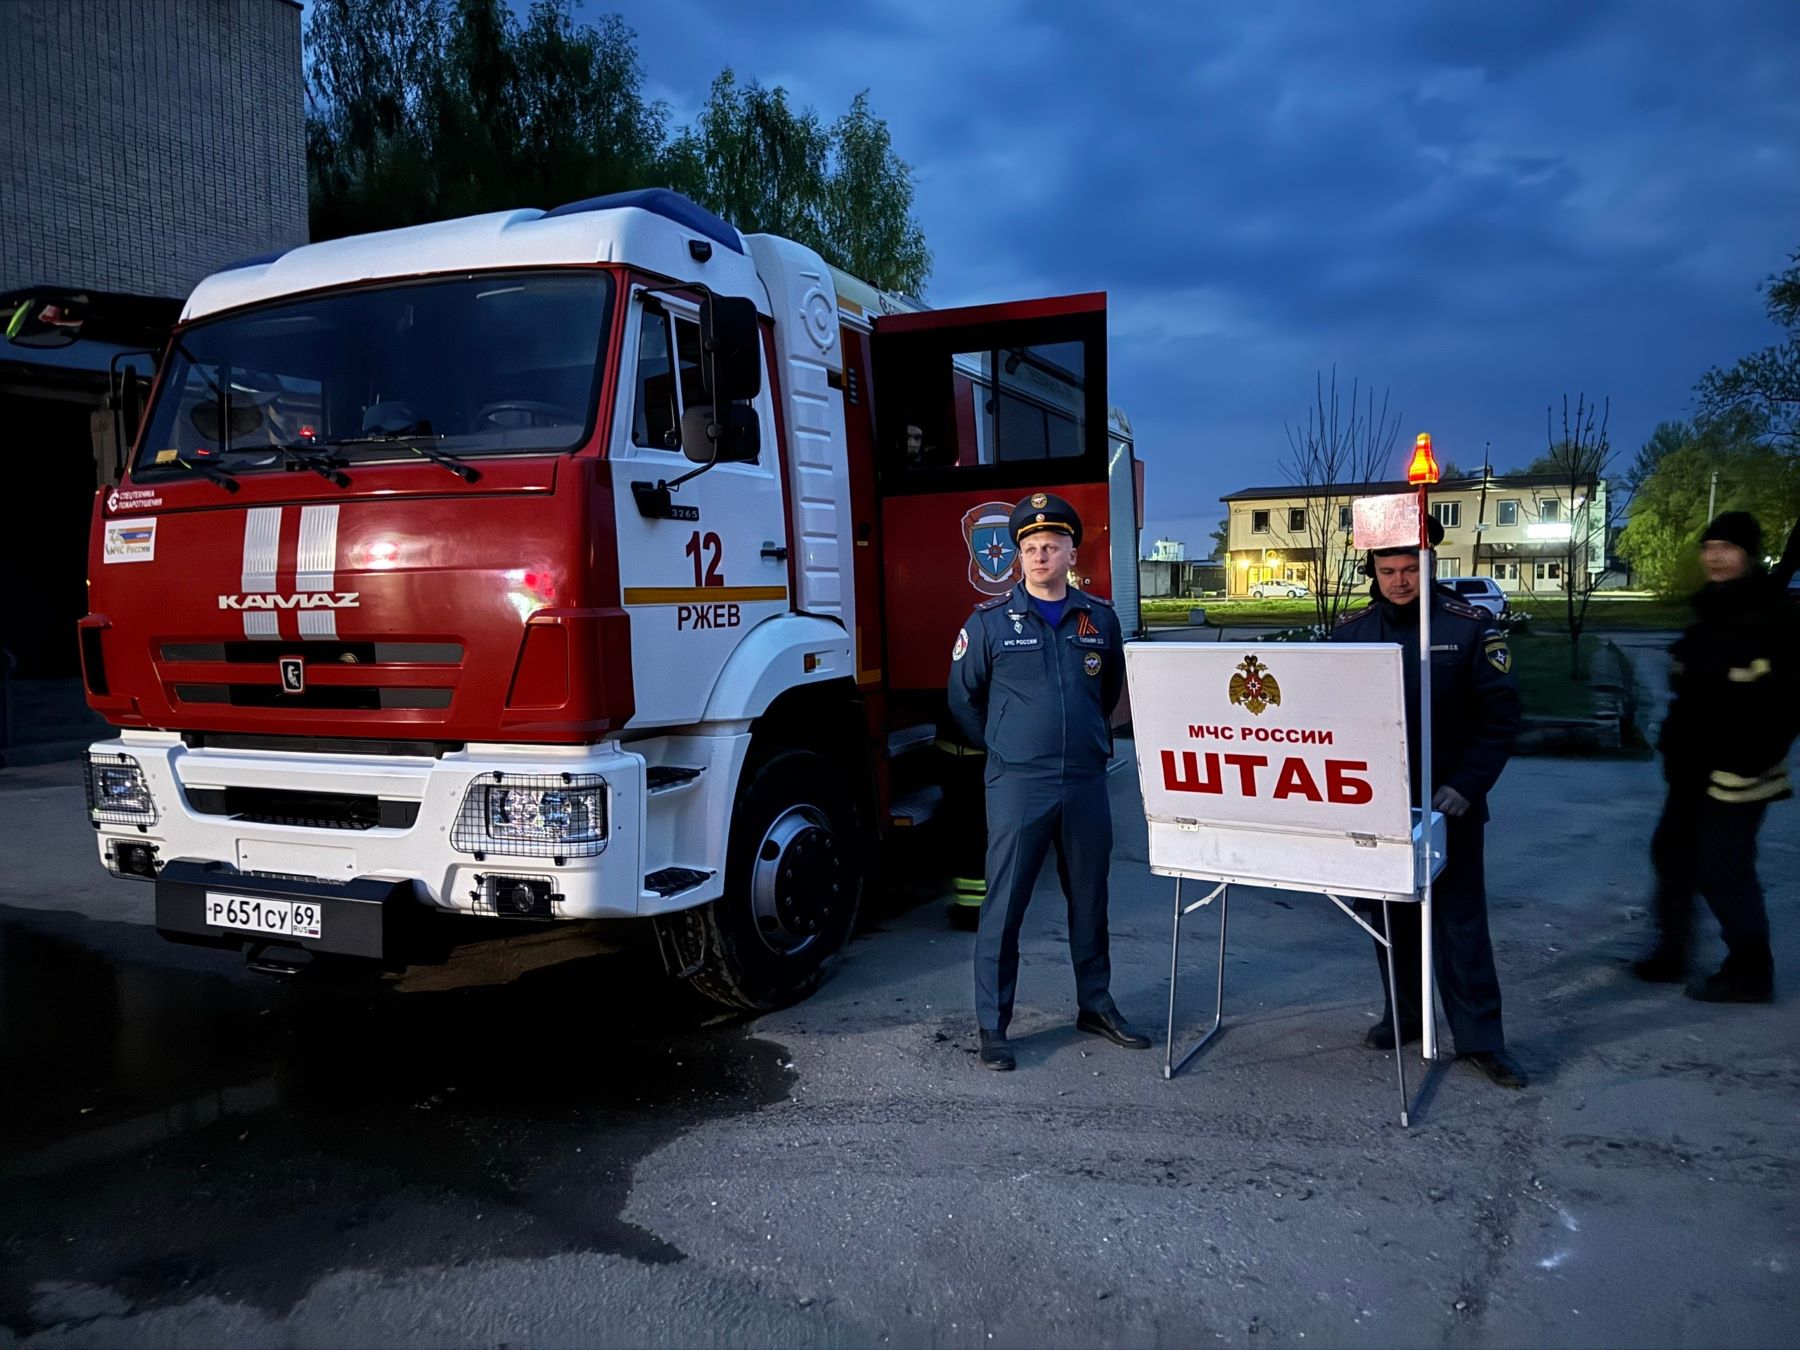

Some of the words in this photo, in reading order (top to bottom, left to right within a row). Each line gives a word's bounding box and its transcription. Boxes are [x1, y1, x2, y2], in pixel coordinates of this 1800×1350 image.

[119, 490, 155, 500] СПЕЦТЕХНИКА
[685, 531, 725, 587] 12
[218, 592, 360, 609] KAMAZ
[677, 604, 741, 631] РЖЕВ
[1188, 725, 1234, 741] МЧС
[1241, 727, 1334, 745] РОССИИ
[1160, 749, 1374, 805] ШТАБ
[294, 905, 314, 926] 69
[293, 925, 308, 934] RUS
